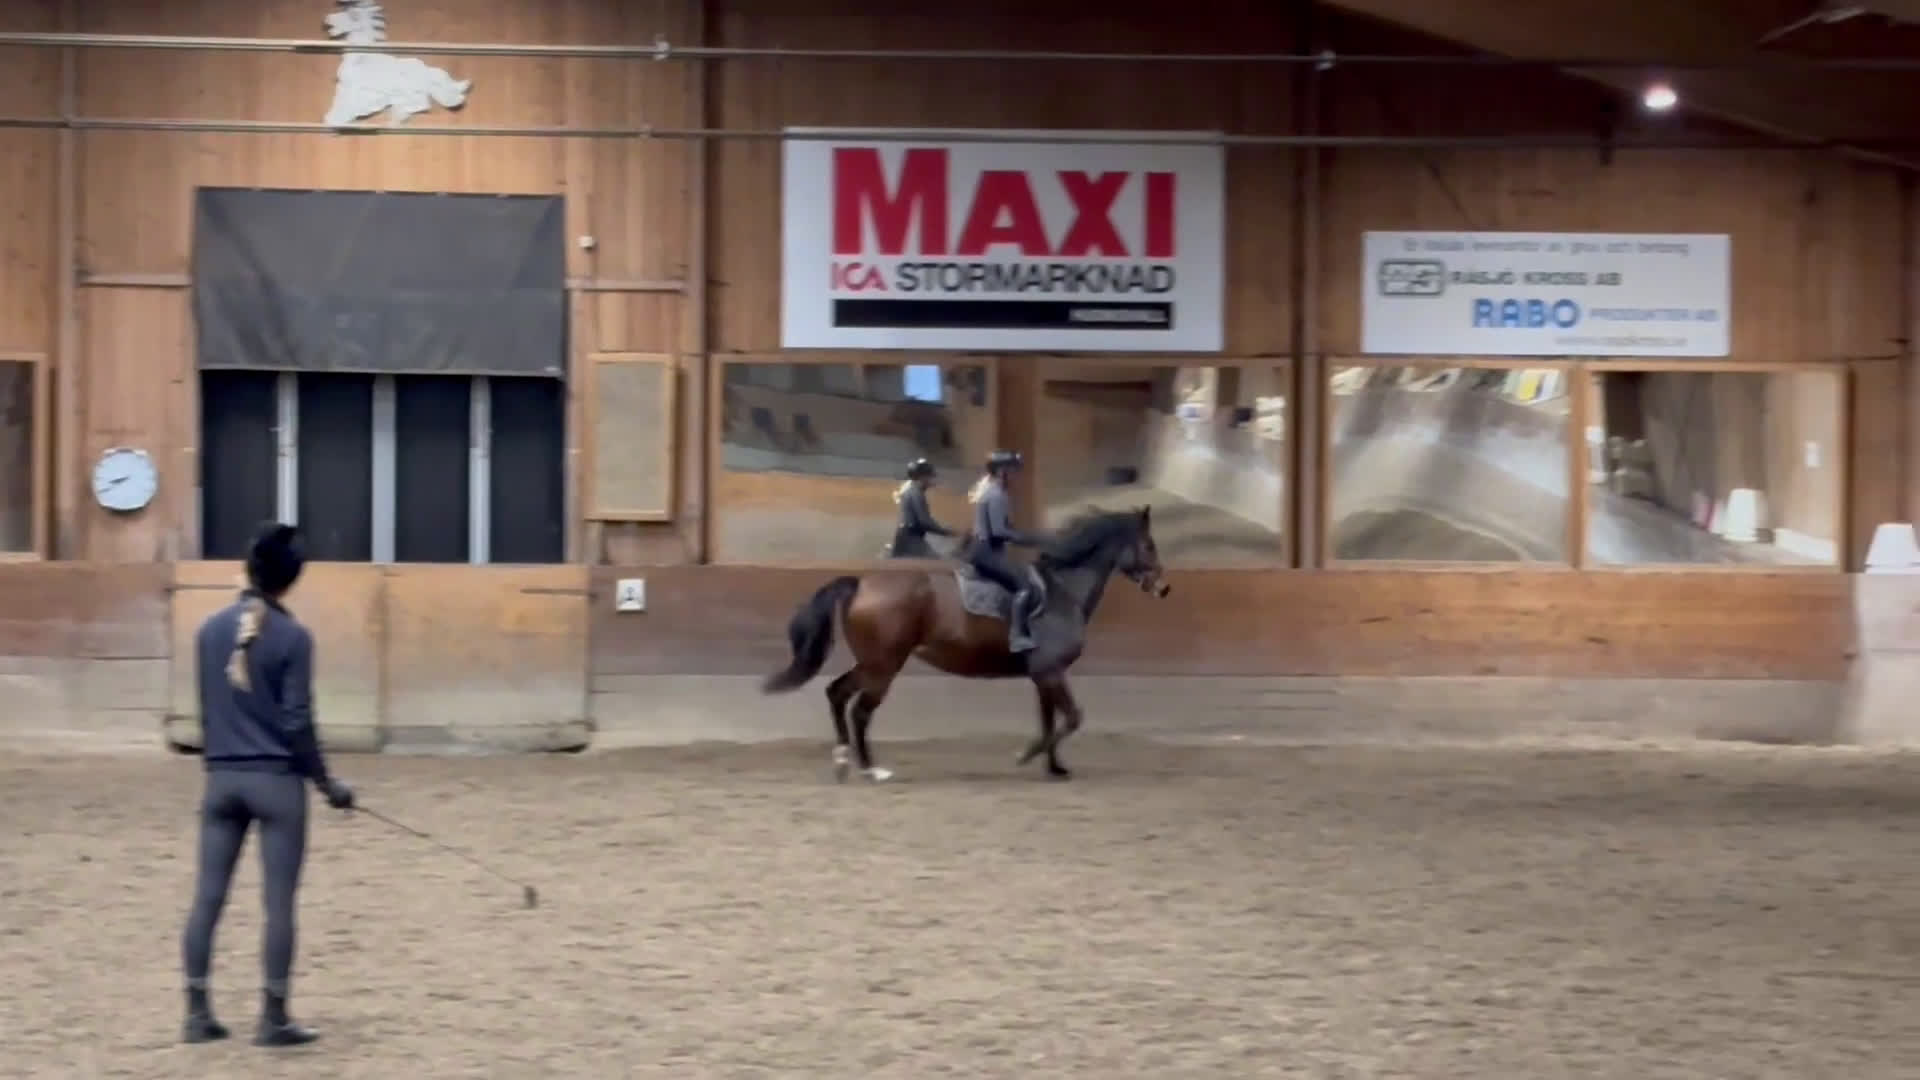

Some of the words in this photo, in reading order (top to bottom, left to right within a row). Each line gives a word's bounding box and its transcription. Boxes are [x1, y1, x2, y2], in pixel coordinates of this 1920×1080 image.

[832, 147, 1177, 258] MAXI
[830, 263, 887, 291] ICA
[896, 263, 1175, 293] STORMARKNAD
[1472, 299, 1580, 328] RABO
